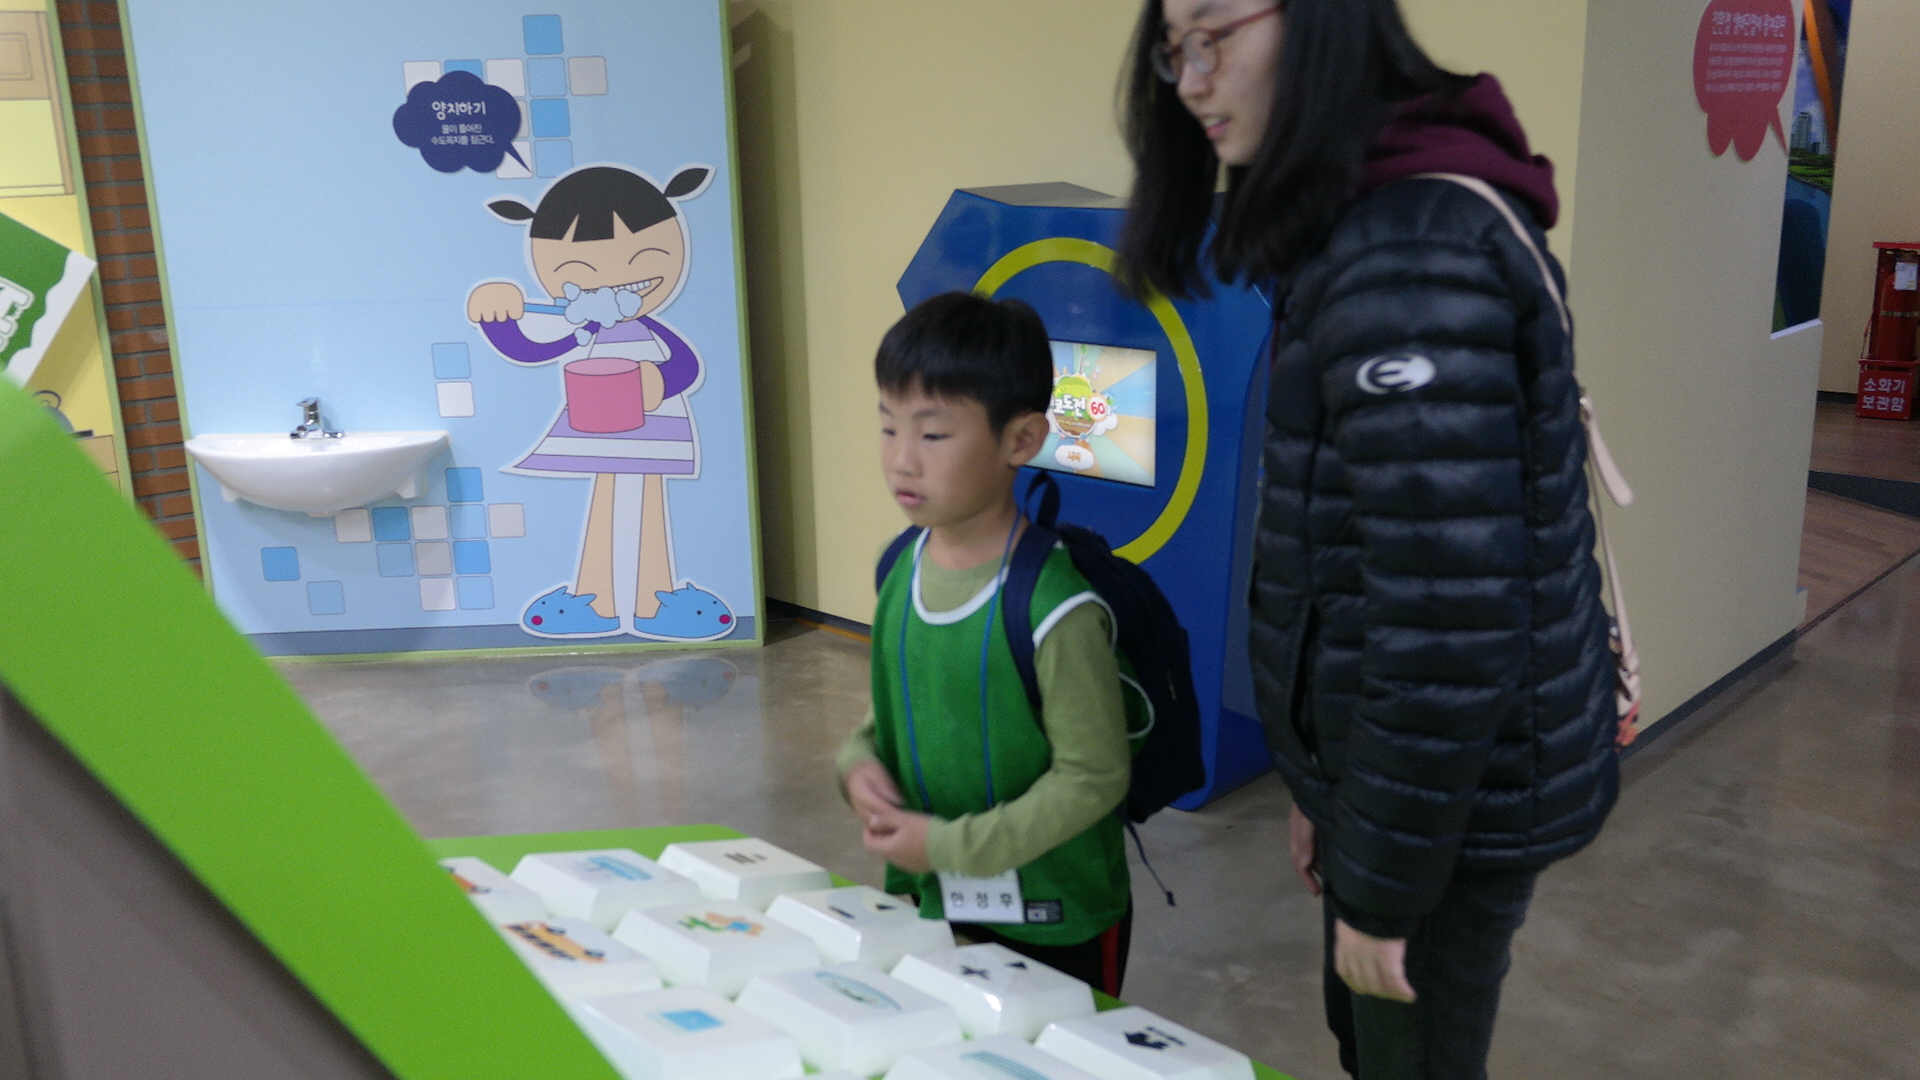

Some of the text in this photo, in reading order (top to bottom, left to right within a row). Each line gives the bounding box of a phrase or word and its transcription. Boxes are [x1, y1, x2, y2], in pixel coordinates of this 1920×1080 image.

[431, 101, 487, 121] 양치하기
[1863, 377, 1906, 394] 소화기
[1090, 401, 1106, 416] 60
[1862, 395, 1905, 412] 보관함
